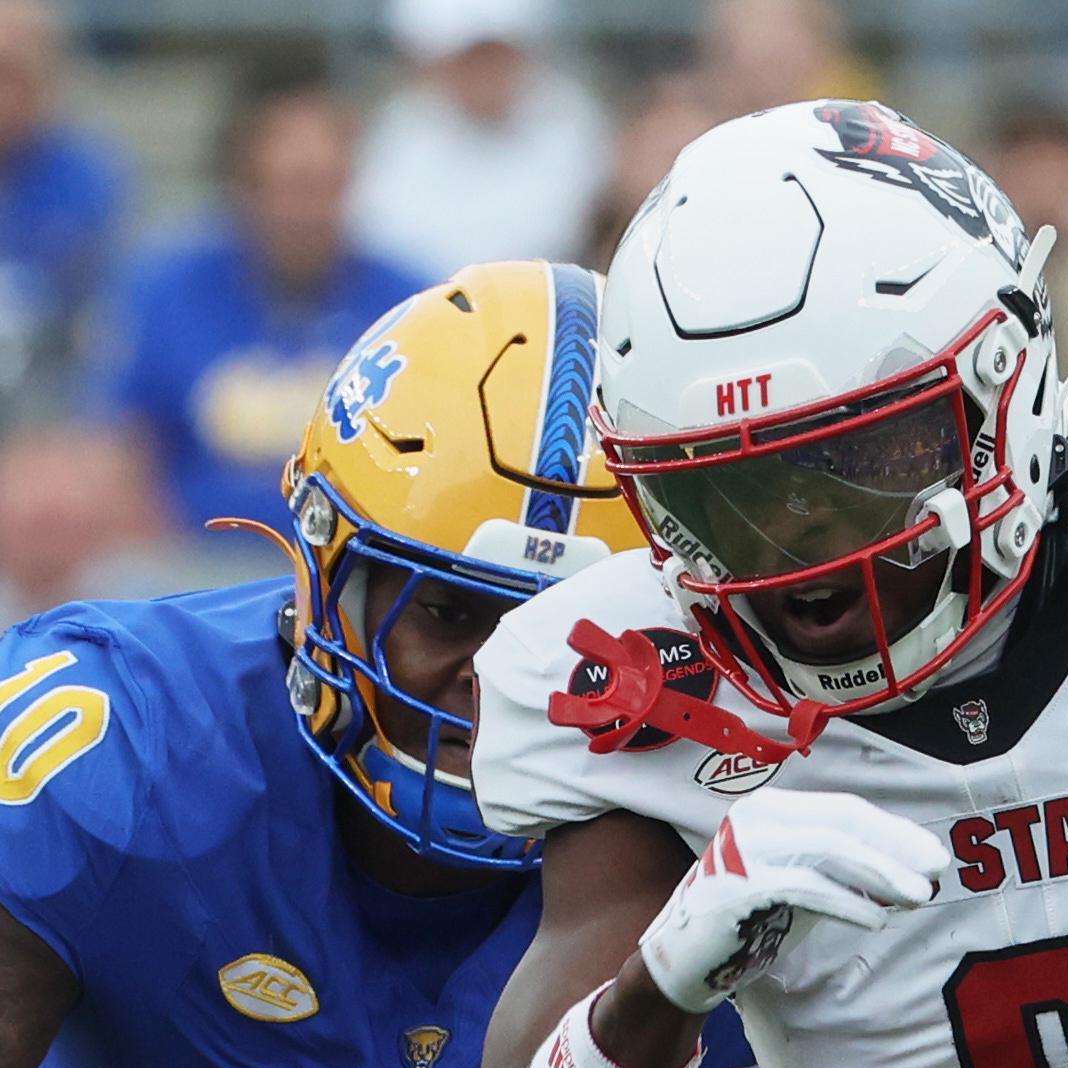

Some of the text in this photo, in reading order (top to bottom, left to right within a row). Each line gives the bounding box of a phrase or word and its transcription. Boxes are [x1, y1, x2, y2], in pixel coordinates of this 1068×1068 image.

[715, 373, 774, 417] HTT
[523, 535, 567, 565] H2P
[660, 515, 734, 584] Riddel
[817, 663, 887, 690] Riddel
[0, 650, 111, 806] 10
[228, 970, 309, 1008] ACC
